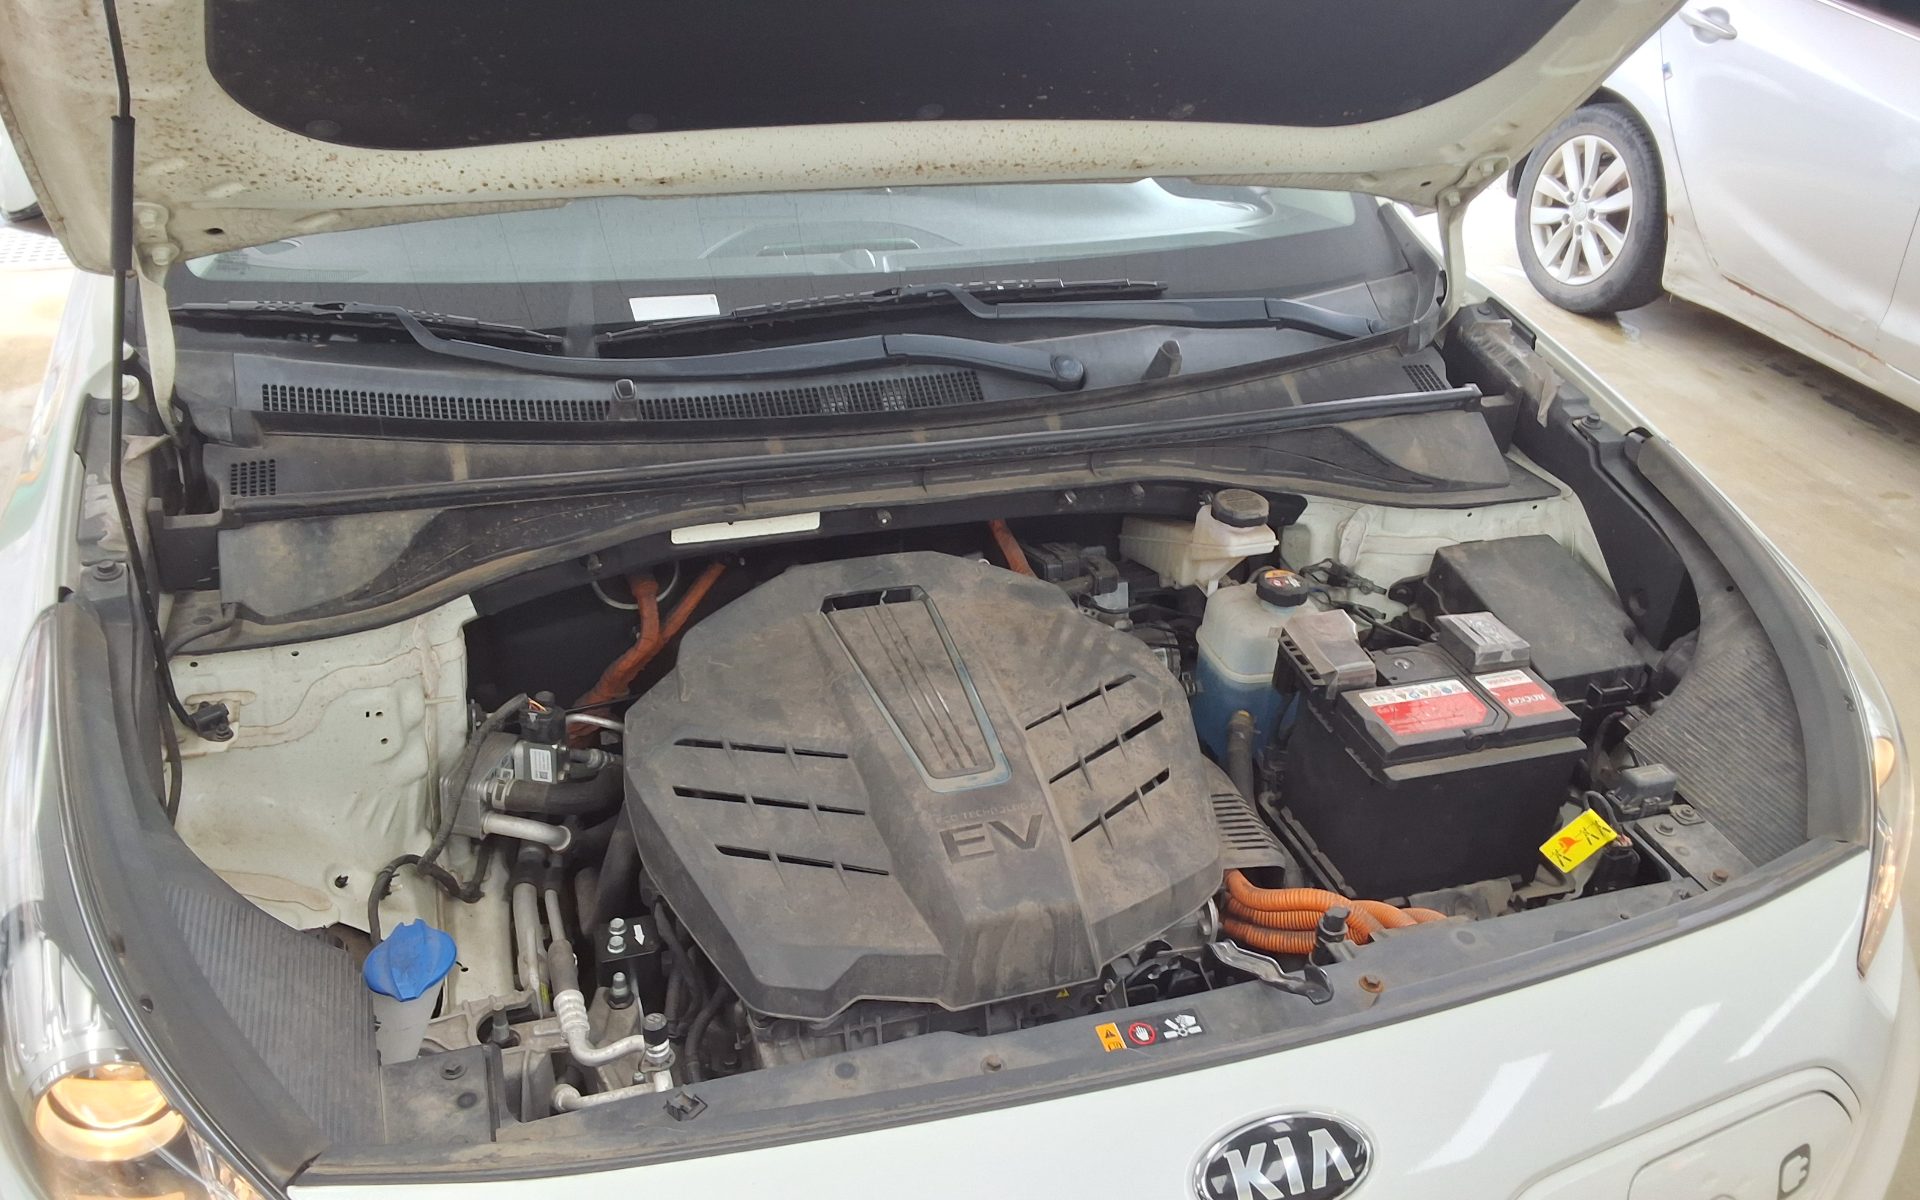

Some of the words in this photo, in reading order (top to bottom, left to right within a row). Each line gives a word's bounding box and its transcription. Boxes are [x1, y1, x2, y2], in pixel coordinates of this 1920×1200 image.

[1507, 694, 1546, 705] ROCKET
[939, 814, 1043, 864] EV
[1223, 1128, 1355, 1200] KIA
